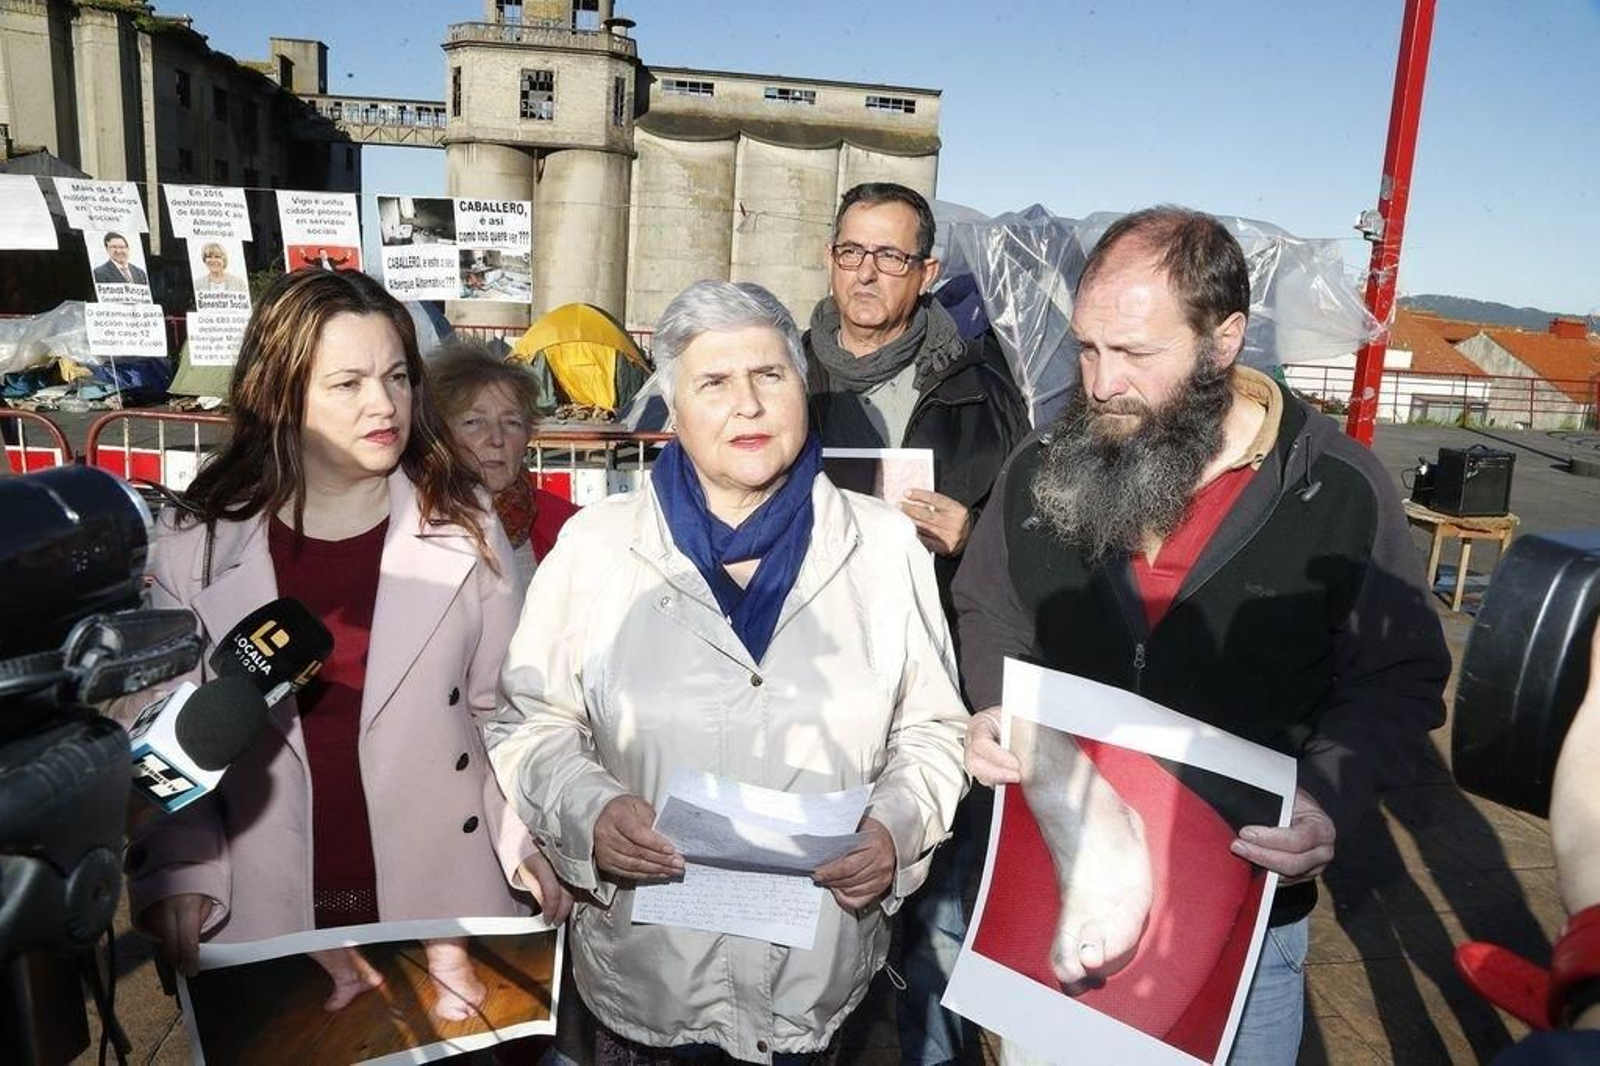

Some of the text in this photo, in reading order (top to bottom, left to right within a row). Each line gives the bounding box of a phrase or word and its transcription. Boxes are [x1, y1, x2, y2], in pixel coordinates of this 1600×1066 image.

[203, 189, 225, 198] 2016
[171, 199, 222, 207] destinamos
[291, 196, 313, 207] Vigo
[321, 199, 345, 207] unha
[285, 207, 353, 217] cidade pioneira
[459, 200, 528, 219] CABALLERO,
[193, 218, 232, 228] Albergue
[296, 218, 346, 226] en servizos
[193, 228, 235, 238] Municipal
[307, 228, 338, 236] sociais
[459, 231, 476, 242] como
[477, 231, 489, 242] nos
[197, 299, 250, 310] Benestar Social
[143, 312, 163, 320] para
[234, 633, 272, 676] LOCALIA
[234, 648, 257, 673] VIGO
